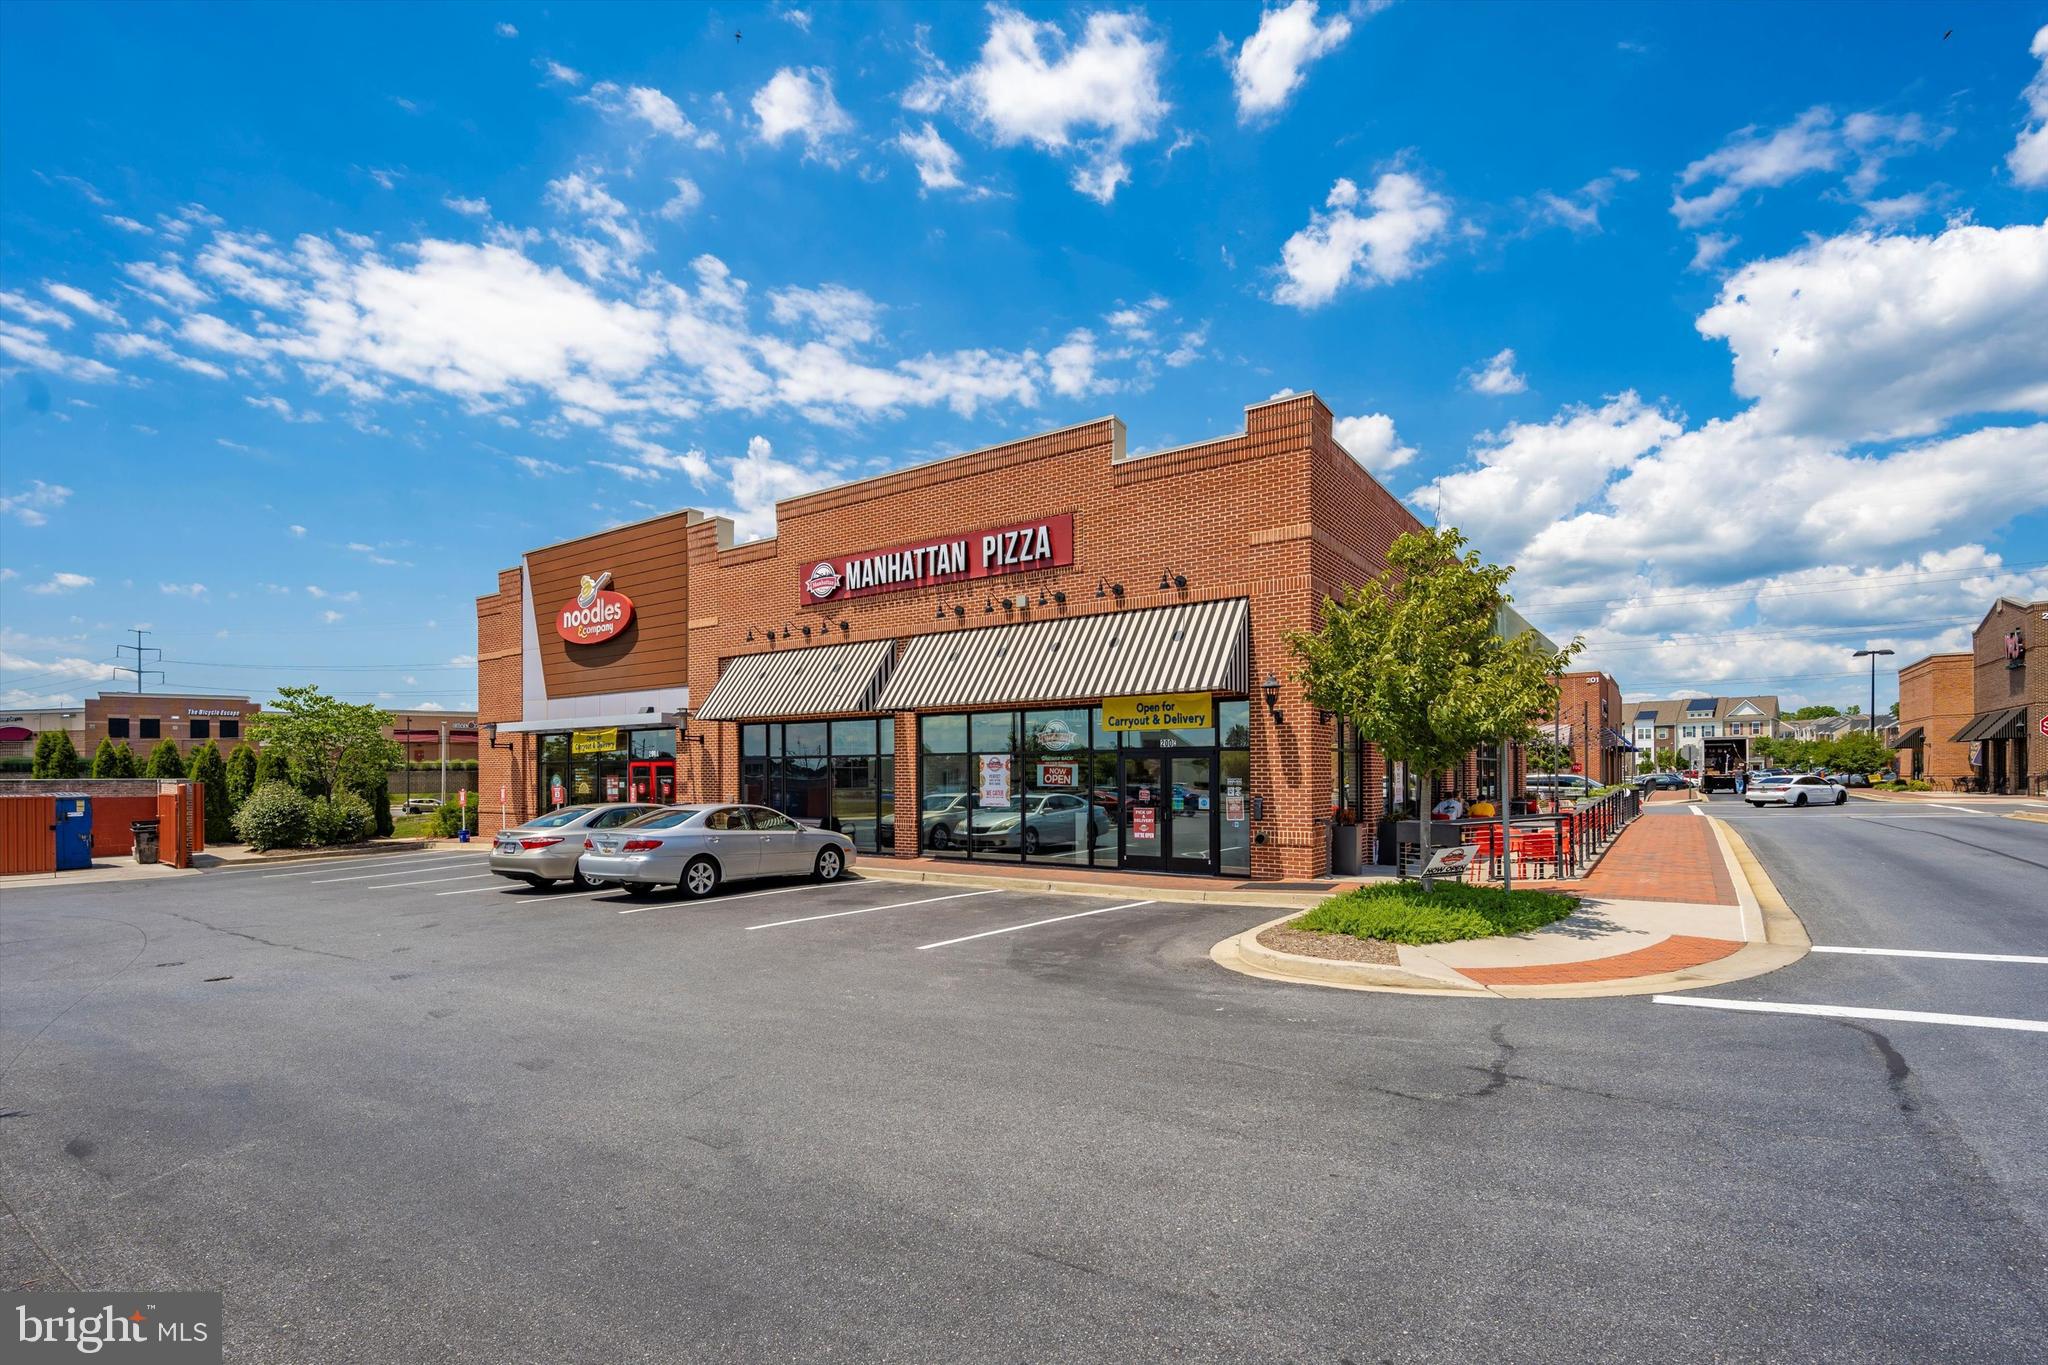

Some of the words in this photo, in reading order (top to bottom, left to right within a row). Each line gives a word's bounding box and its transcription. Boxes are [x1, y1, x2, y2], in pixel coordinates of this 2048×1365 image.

[846, 541, 967, 591] MANHATTAN
[982, 525, 1052, 568] PIZZA
[563, 598, 621, 628] noodles
[1136, 702, 1160, 715] Open
[1162, 701, 1175, 711] for
[1108, 716, 1149, 728] Carryout
[1152, 714, 1160, 724] &
[1164, 713, 1205, 725] Delivery
[1049, 767, 1067, 775] NOW
[1044, 774, 1071, 784] OPEN
